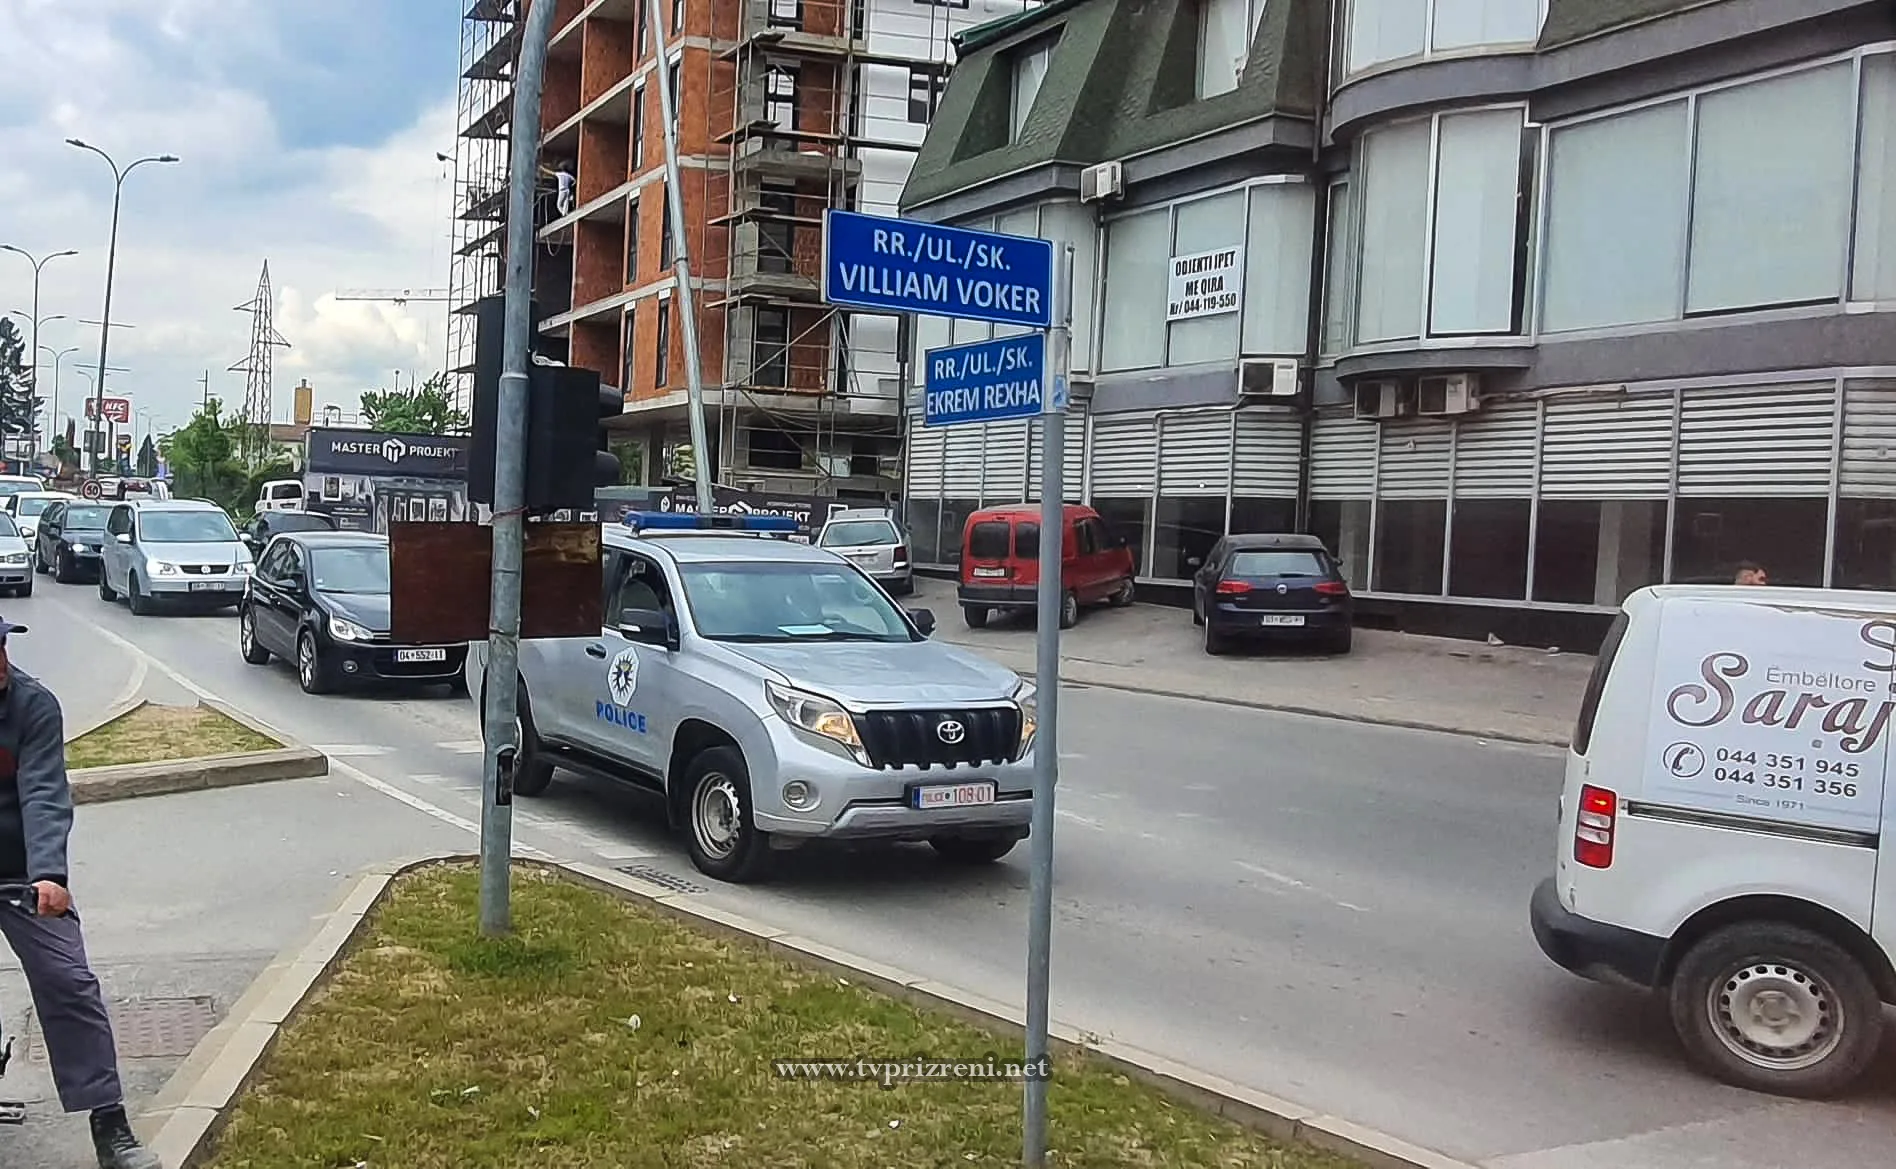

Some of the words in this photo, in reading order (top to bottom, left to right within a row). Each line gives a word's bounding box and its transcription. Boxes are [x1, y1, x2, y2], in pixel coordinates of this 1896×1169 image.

[873, 229, 1011, 271] RR./UL./SK.
[840, 262, 948, 303] VILLIAM
[957, 278, 1041, 314] VOKER
[1185, 280, 1199, 297] ME
[1200, 276, 1224, 296] QIRA
[934, 346, 1033, 381] RR./UL./SK.
[927, 387, 980, 416] EKREM
[984, 378, 1041, 410] REXHA
[331, 441, 381, 455] MASTER
[409, 446, 457, 459] PROJEKT
[86, 484, 98, 495] 50
[596, 700, 647, 733] POLICE
[1715, 747, 1758, 766] 044
[1765, 753, 1805, 771] 351
[1815, 760, 1860, 778] 945
[1714, 767, 1756, 785] 044
[1763, 773, 1803, 791] 351
[1814, 779, 1858, 798] 356
[1736, 794, 1770, 807] Since
[1776, 800, 1804, 810] 1971
